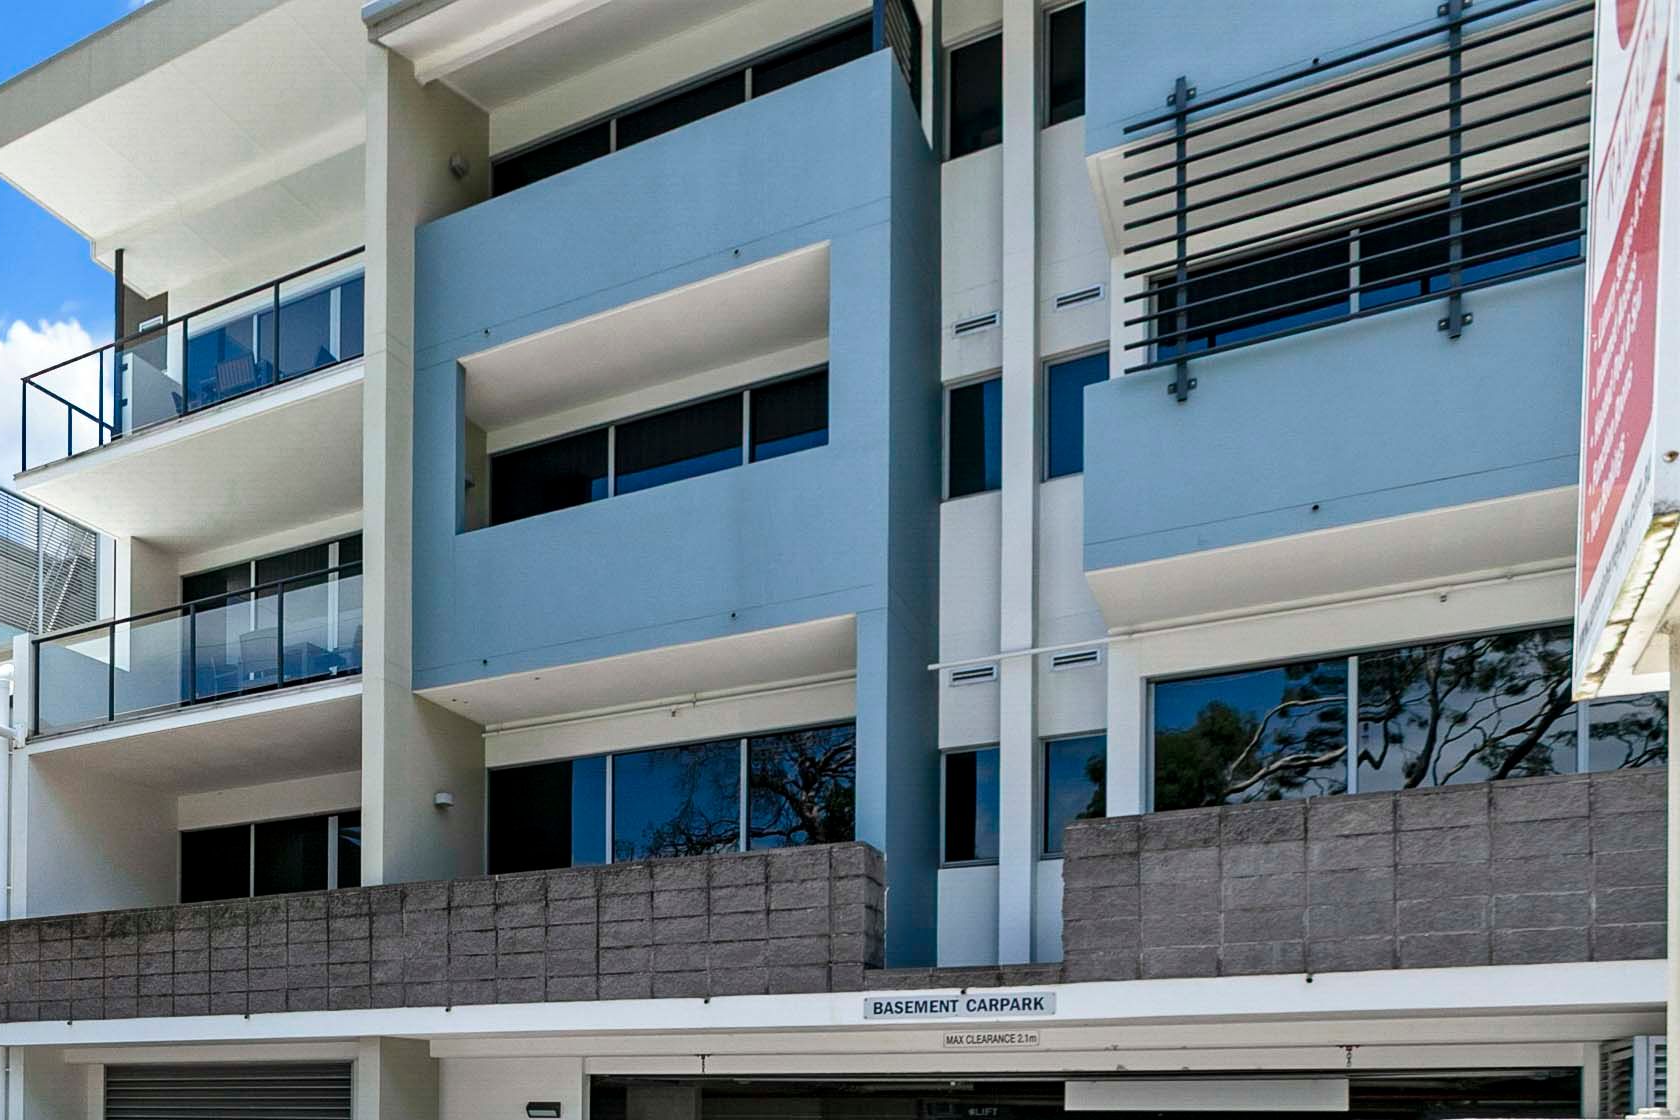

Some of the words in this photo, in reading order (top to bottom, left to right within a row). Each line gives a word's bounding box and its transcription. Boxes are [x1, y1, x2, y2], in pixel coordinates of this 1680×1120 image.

[872, 999, 960, 1015] BASEMENT
[965, 996, 1045, 1012] CARPARK
[946, 1035, 964, 1045] MAX
[965, 1033, 1017, 1045] CLEARANCE
[975, 1107, 999, 1116] LIFT
